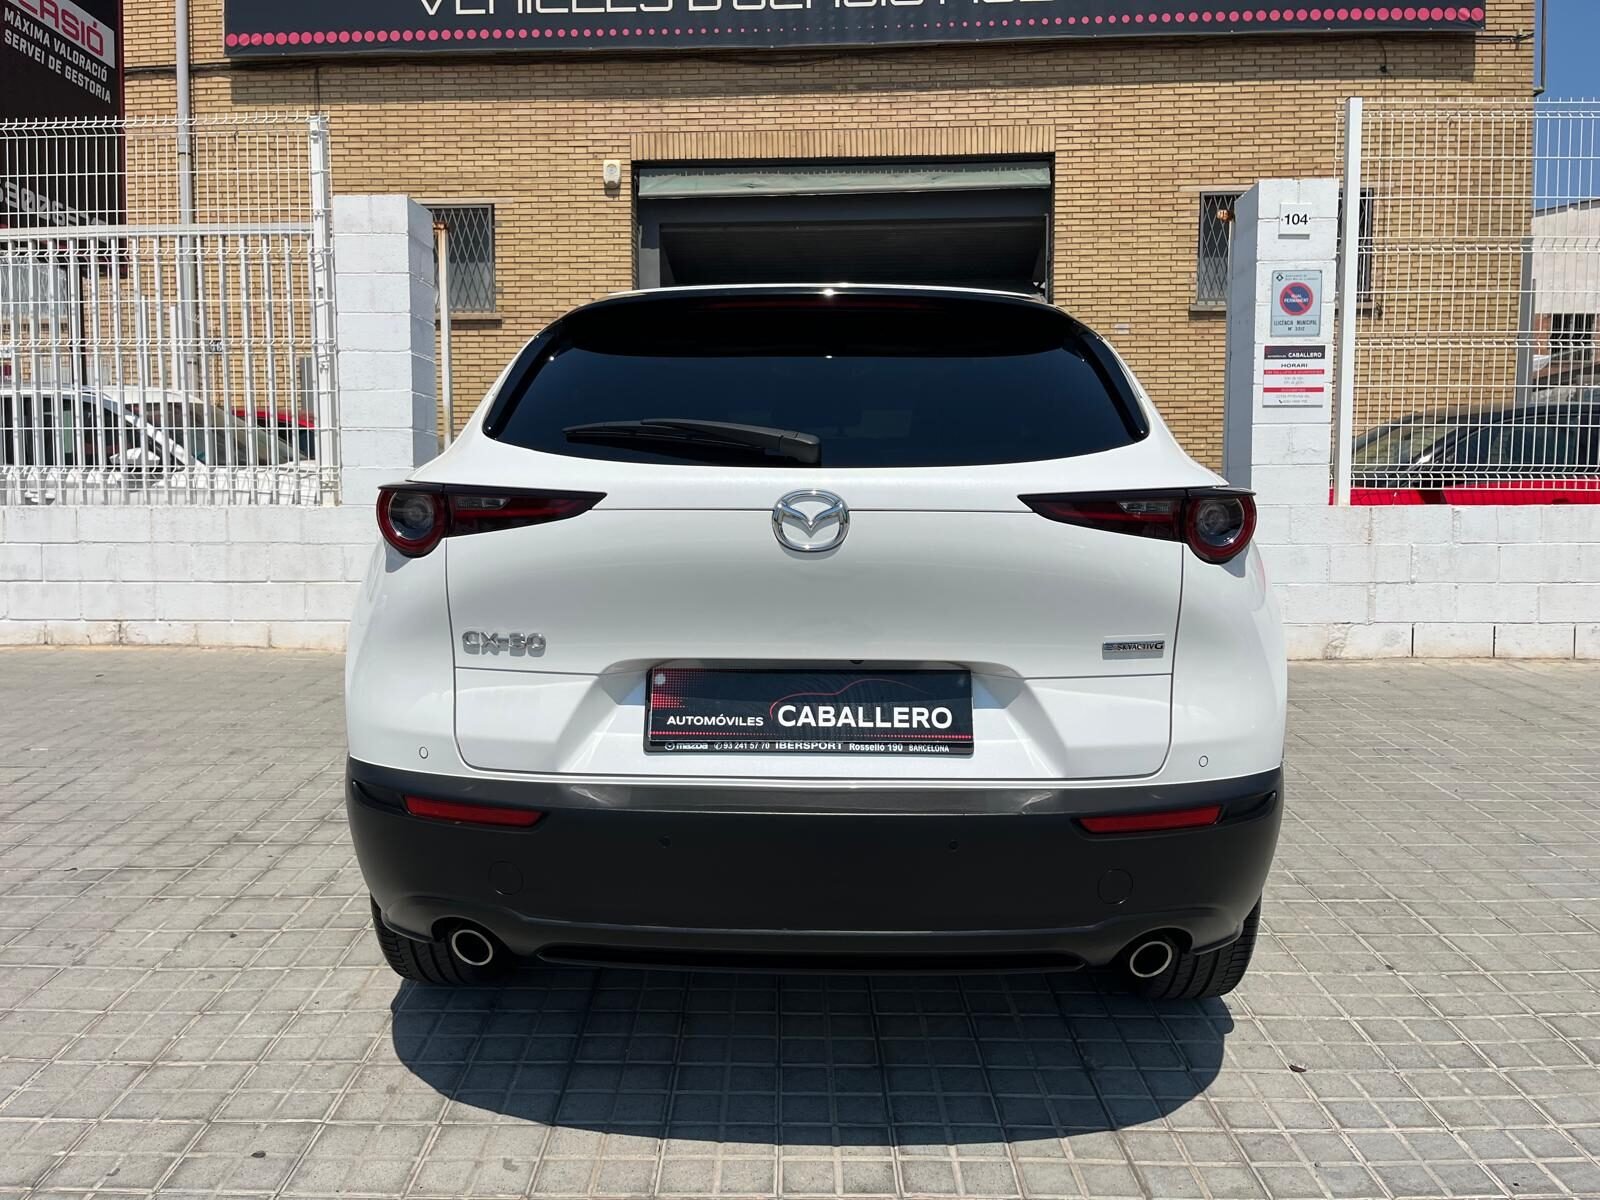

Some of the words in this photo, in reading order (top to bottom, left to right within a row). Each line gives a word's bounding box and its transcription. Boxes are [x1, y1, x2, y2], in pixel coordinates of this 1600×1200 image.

[4, 7, 50, 48] MÀXIMA
[53, 37, 107, 82] VALORACIÓ
[4, 28, 45, 64] SERVEI
[48, 55, 62, 74] DE
[64, 65, 111, 104] GESTORIA
[1284, 213, 1308, 225] 104
[462, 631, 546, 657] CX-30
[666, 714, 764, 727] AUTOMÓVILES
[777, 705, 953, 729] CABALLERO
[723, 741, 733, 750] 93
[734, 741, 748, 750] 241
[775, 741, 842, 750] IBERSPORT
[888, 743, 903, 752] 190
[908, 744, 950, 752] BARCELONA
